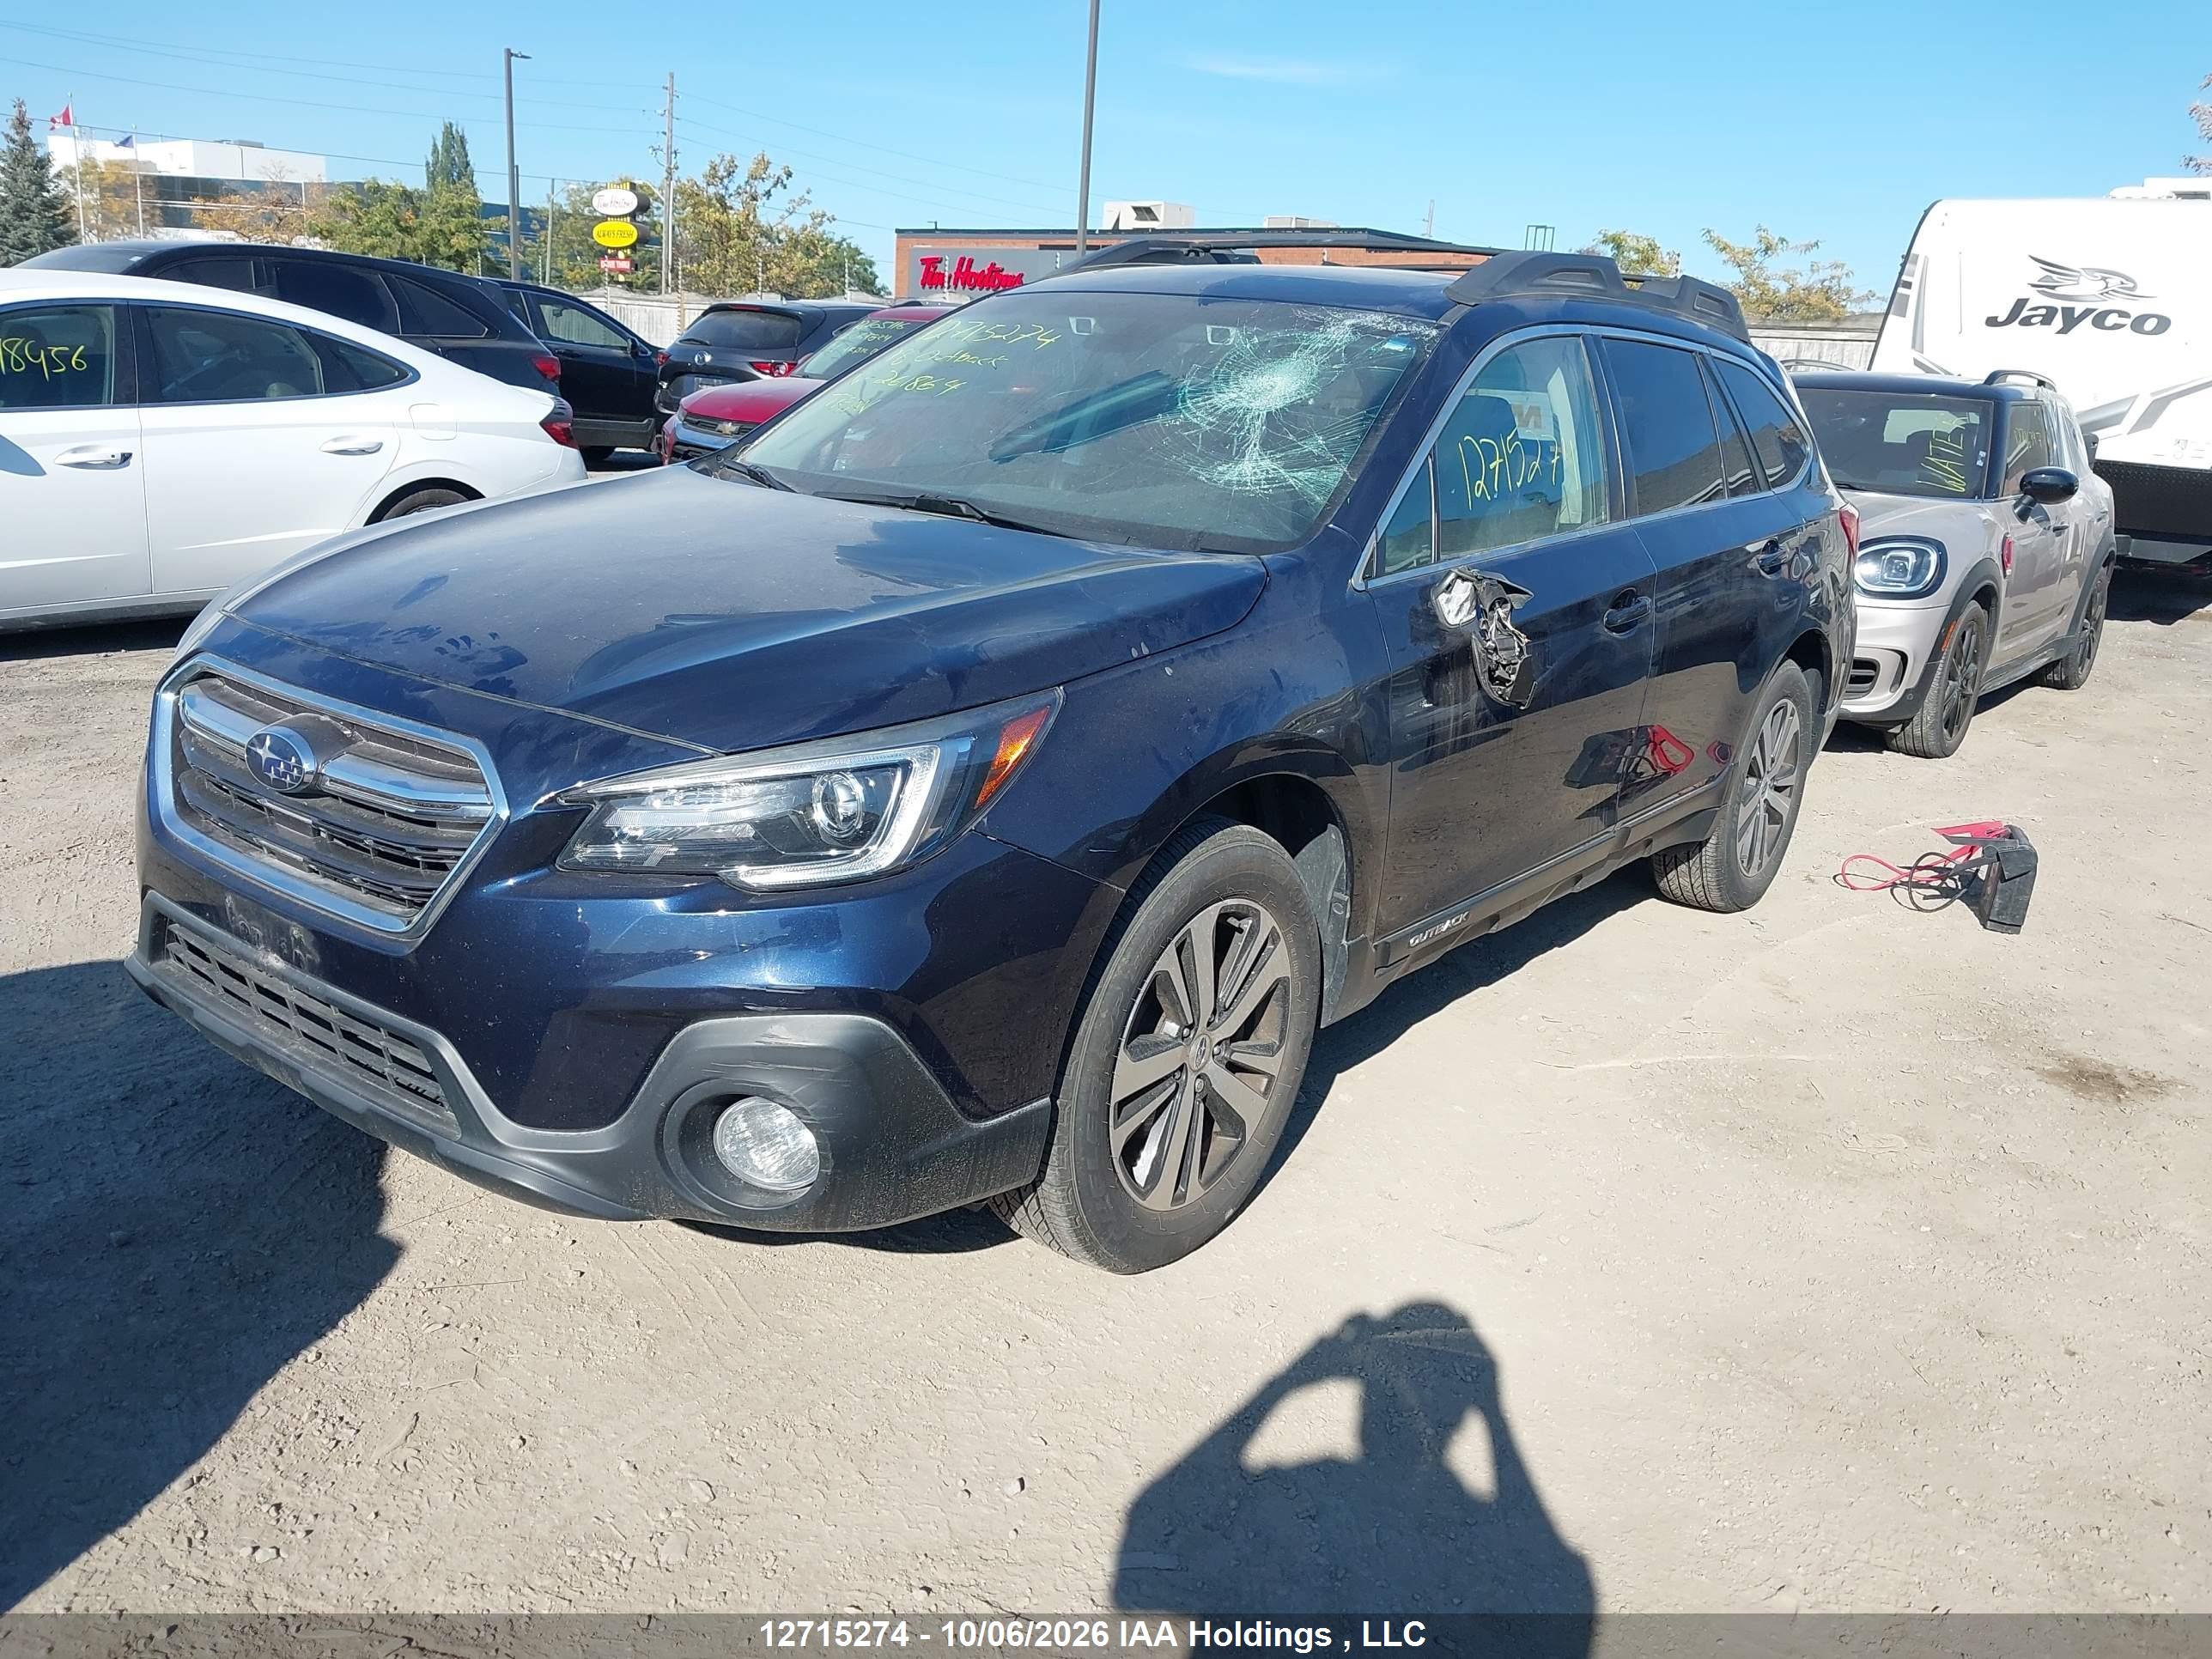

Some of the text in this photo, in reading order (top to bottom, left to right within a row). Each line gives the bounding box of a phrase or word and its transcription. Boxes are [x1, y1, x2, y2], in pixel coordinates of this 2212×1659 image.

[919, 256, 1024, 291] Tim Hortons
[1984, 297, 2172, 336] Jayco
[1409, 911, 1470, 947] OUTBACK
